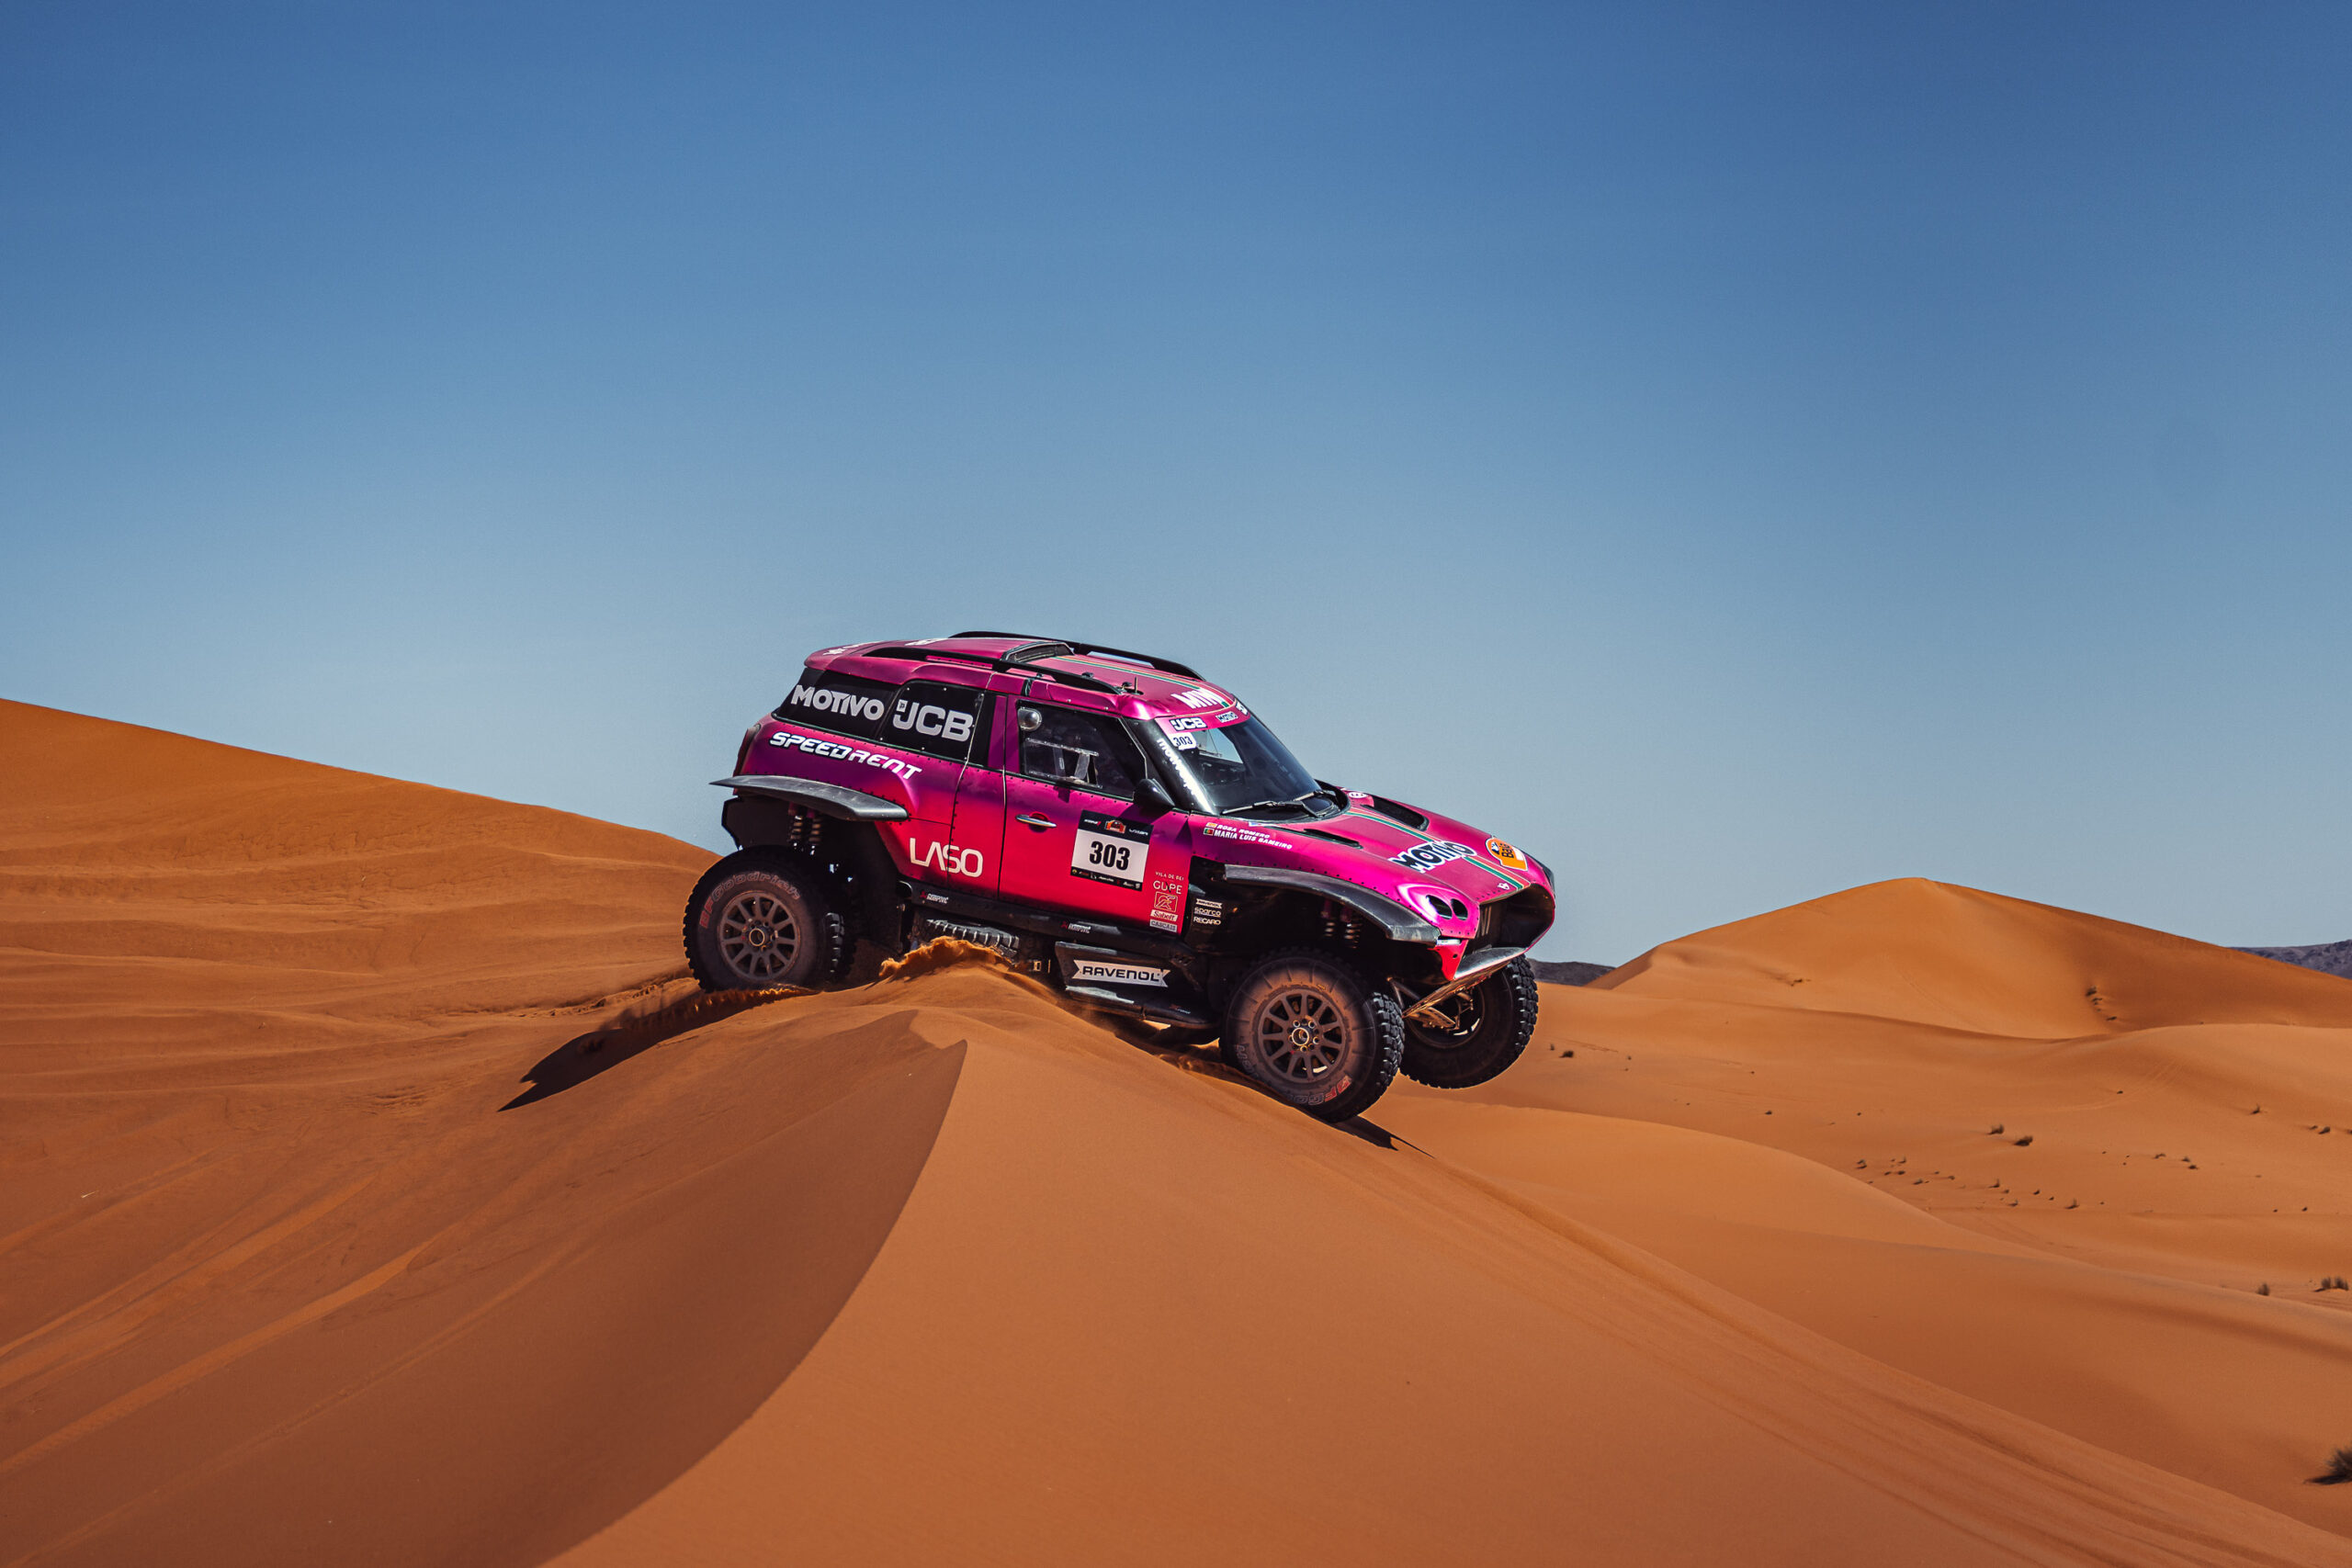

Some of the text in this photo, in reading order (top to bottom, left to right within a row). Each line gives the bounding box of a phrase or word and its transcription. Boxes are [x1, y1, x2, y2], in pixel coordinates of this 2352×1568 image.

[791, 684, 885, 721] MOTIVO
[892, 699, 974, 742] JCB
[1170, 716, 1208, 731] JCB
[1172, 736, 1193, 747] 303
[1214, 829, 1293, 850] MARIA LUIS GAMEIRO
[1217, 824, 1271, 839] ROSA ROMERO
[910, 837, 984, 878] LASO
[1089, 840, 1131, 871] 303
[1388, 840, 1477, 873] MOTIVO
[1193, 916, 1222, 925] RECARO
[1082, 965, 1160, 982] RAVENOL
